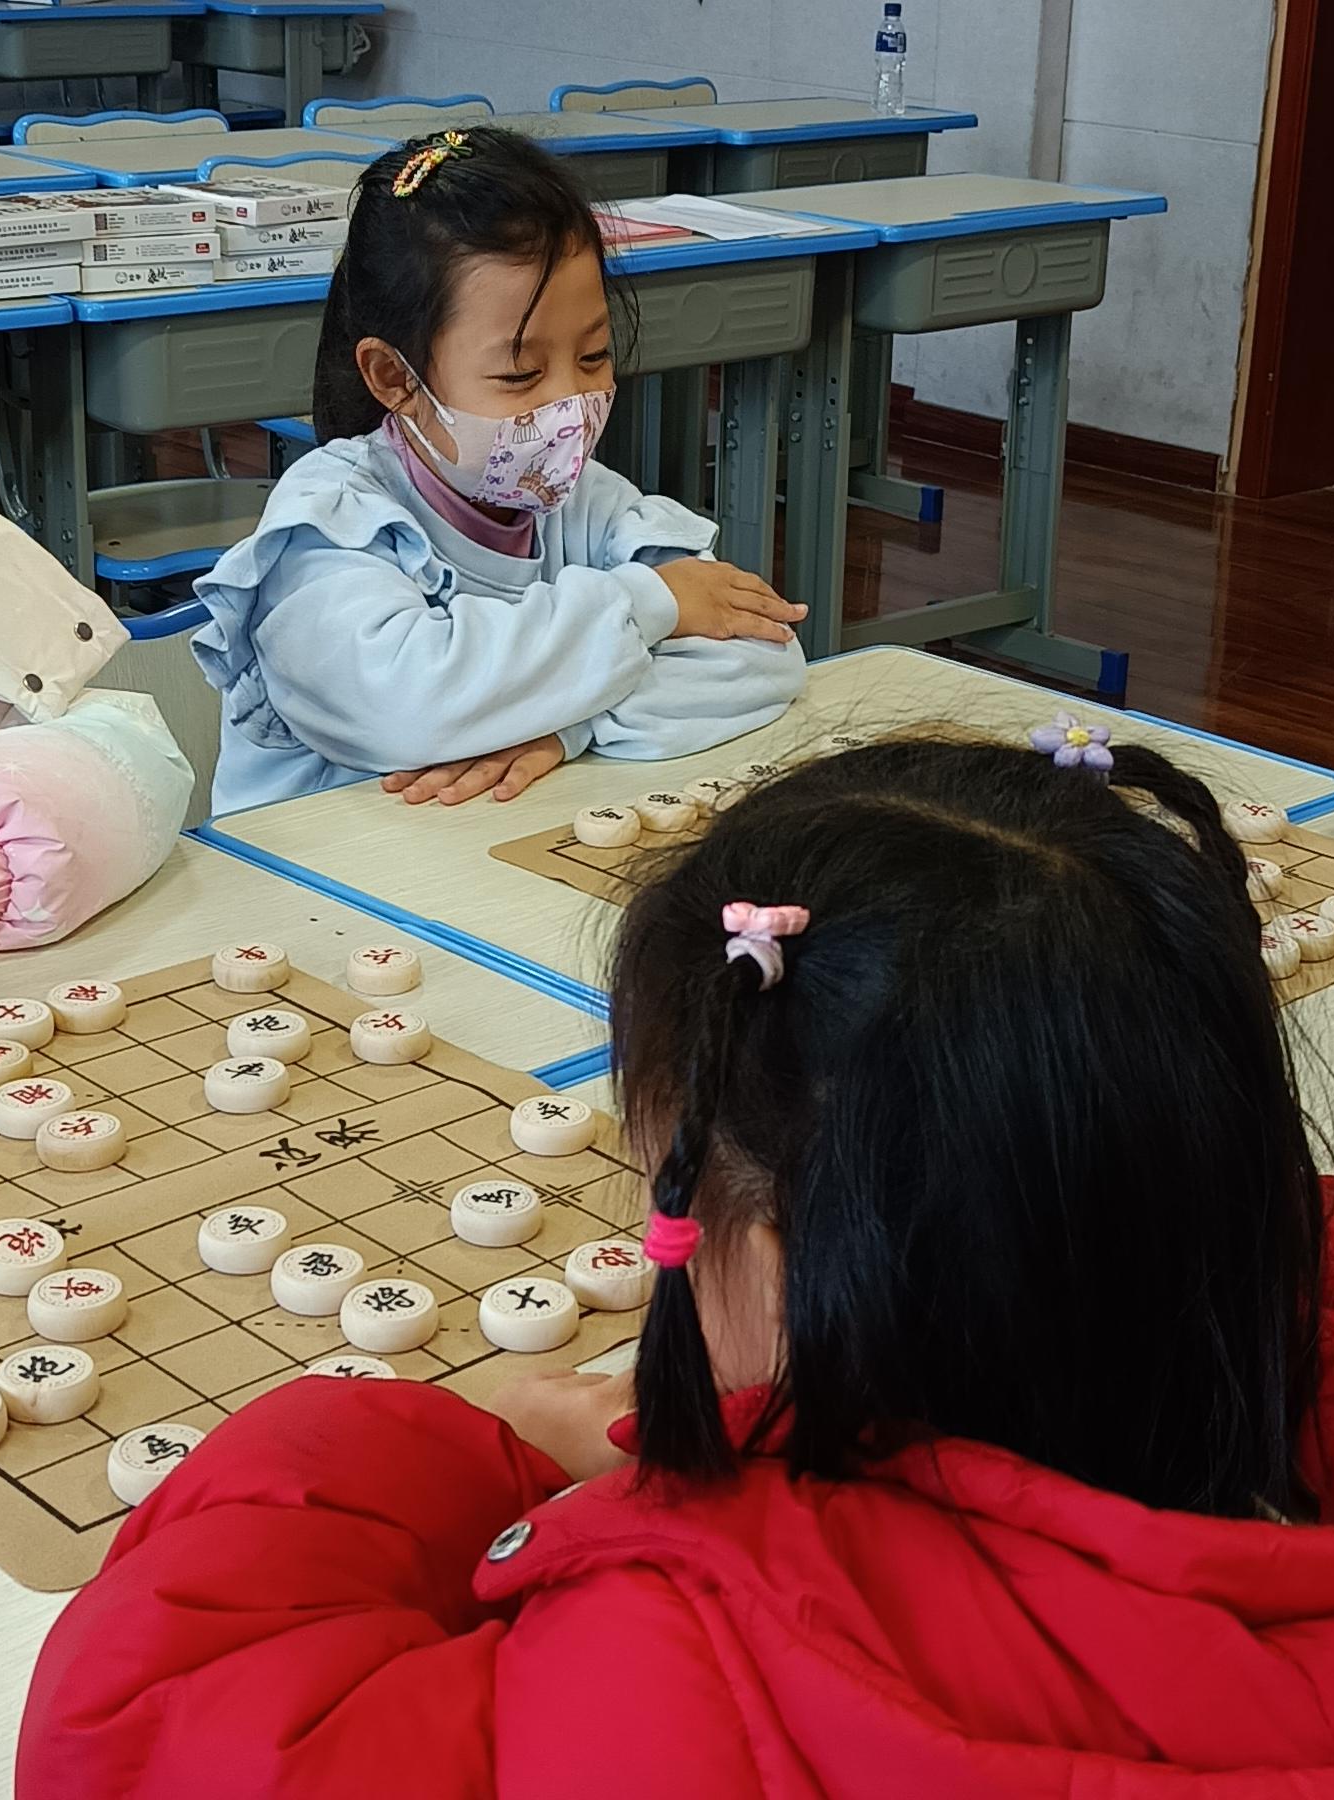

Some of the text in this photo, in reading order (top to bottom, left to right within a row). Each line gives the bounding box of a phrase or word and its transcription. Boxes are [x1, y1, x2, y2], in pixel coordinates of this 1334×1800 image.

[1242, 803, 1273, 816] 兵
[1292, 918, 1318, 932] 士
[363, 949, 401, 964] 兵
[370, 1013, 407, 1032] 兵
[537, 1103, 570, 1120] 卒
[60, 1118, 98, 1137] 兵
[227, 1213, 265, 1235] 卒
[50, 1277, 104, 1300] 車
[507, 1287, 550, 1310] 士
[19, 1357, 74, 1383] 炮
